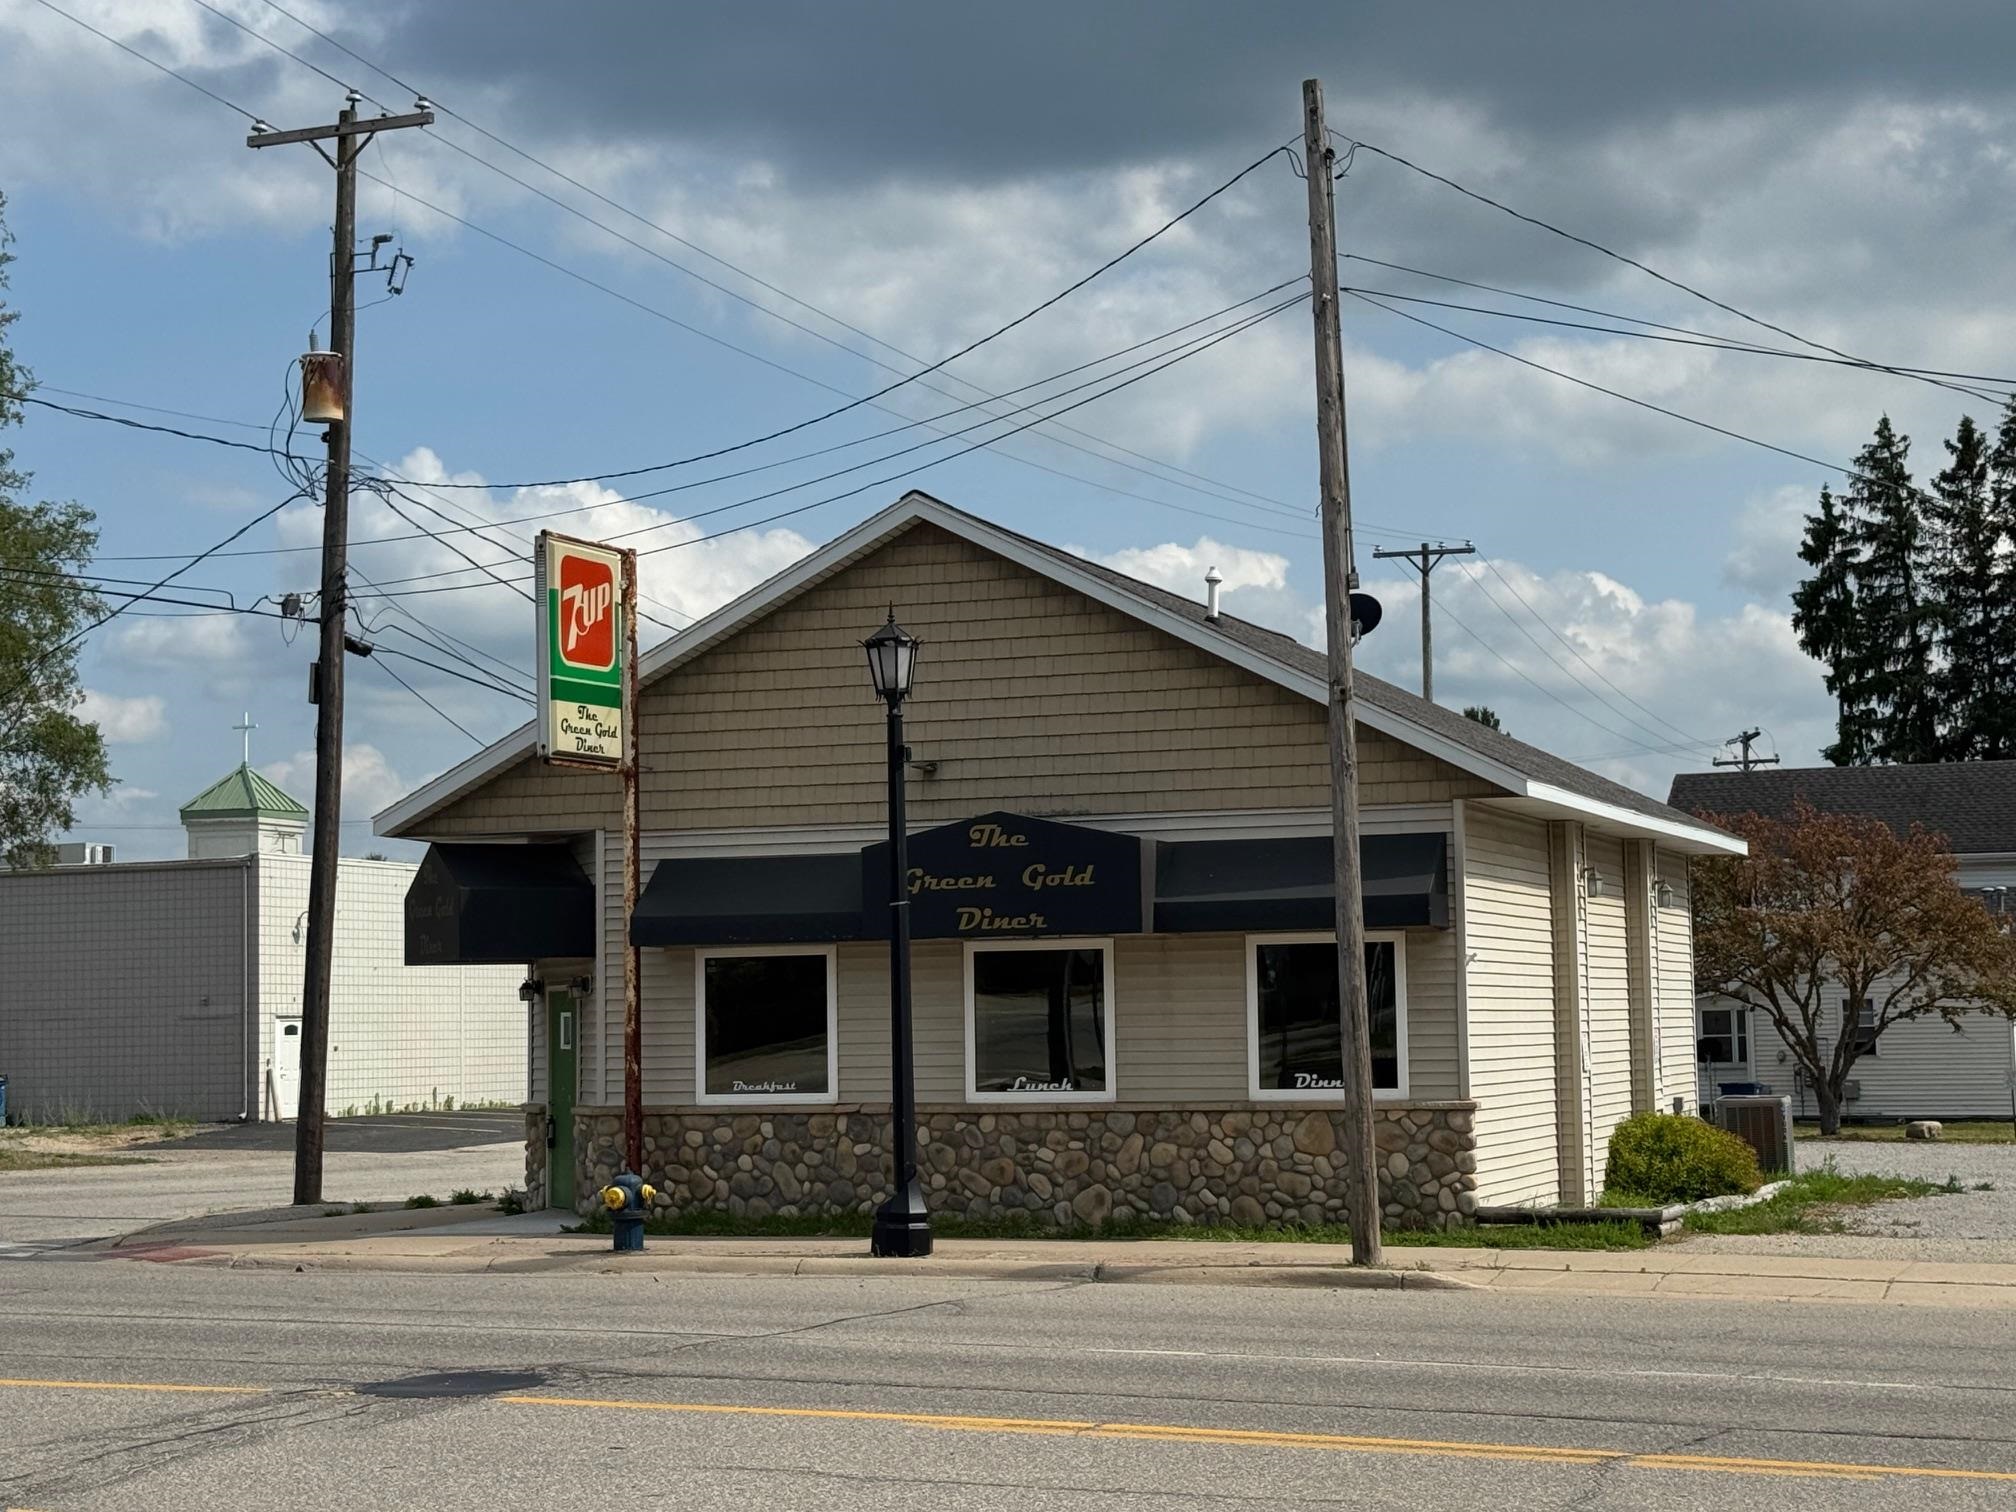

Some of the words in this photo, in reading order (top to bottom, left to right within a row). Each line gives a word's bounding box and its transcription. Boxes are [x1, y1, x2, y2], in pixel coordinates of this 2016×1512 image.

[577, 705, 599, 722] The
[560, 718, 592, 737] Green
[594, 722, 618, 739] Gold
[575, 737, 605, 755] Diner
[968, 824, 1029, 848] The
[906, 868, 997, 895] Green
[1022, 863, 1096, 891] Gold
[956, 907, 1048, 931] Diner
[733, 1080, 797, 1092] Breakfast
[1007, 1076, 1074, 1091] Lunch
[1294, 1073, 1345, 1088] Dinn
